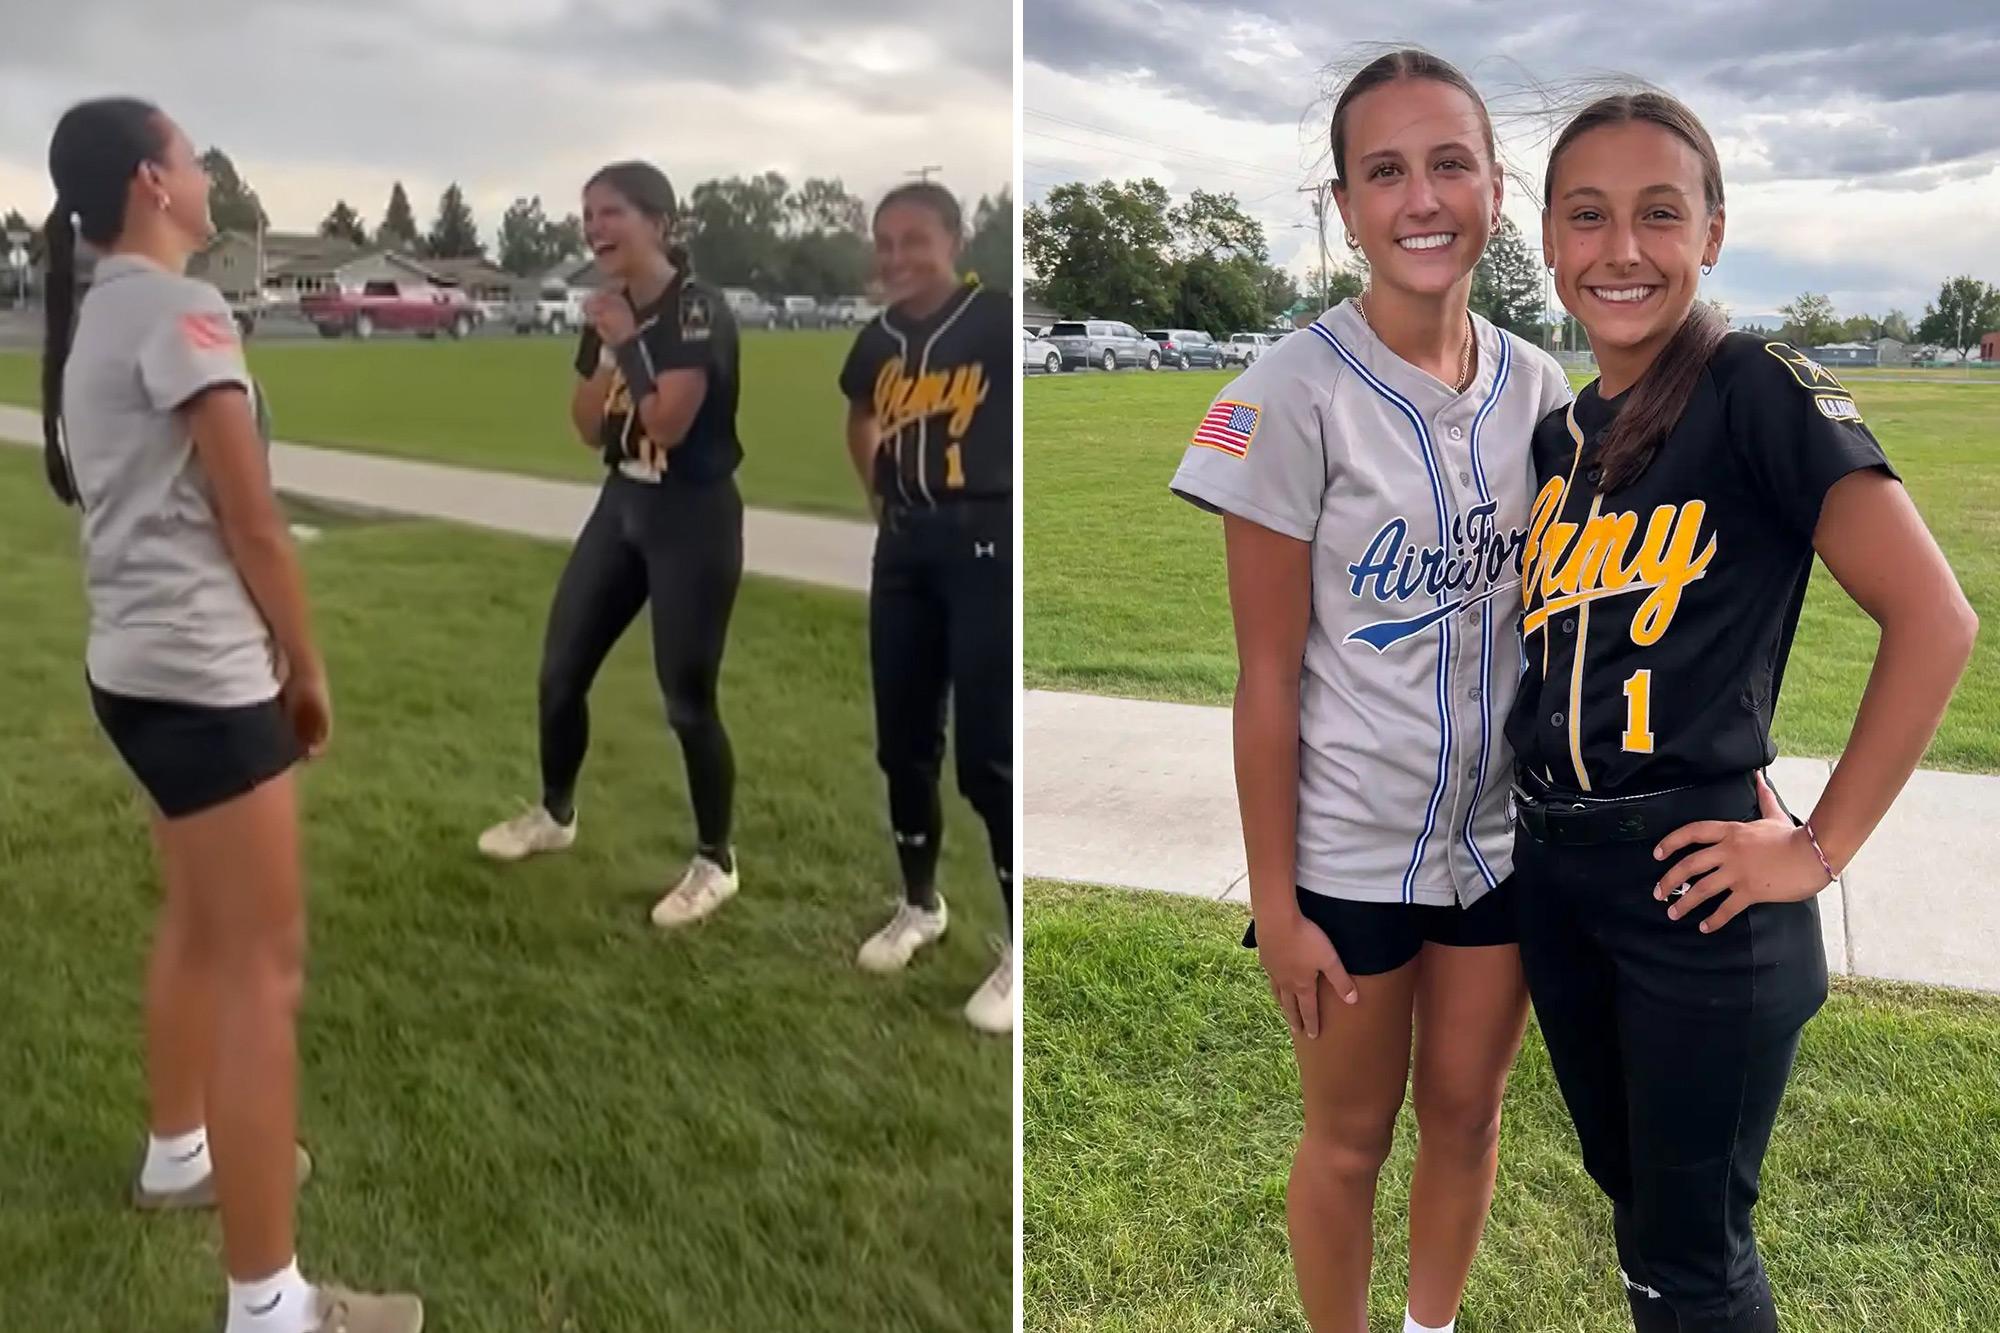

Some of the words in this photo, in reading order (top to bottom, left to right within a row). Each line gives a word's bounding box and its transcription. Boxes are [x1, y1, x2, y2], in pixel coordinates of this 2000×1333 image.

[874, 356, 990, 437] Army
[946, 442, 965, 487] 1
[1348, 516, 1458, 602] Air
[1450, 497, 1528, 592] For
[1522, 475, 1717, 646] Army
[1621, 669, 1654, 753] 1
